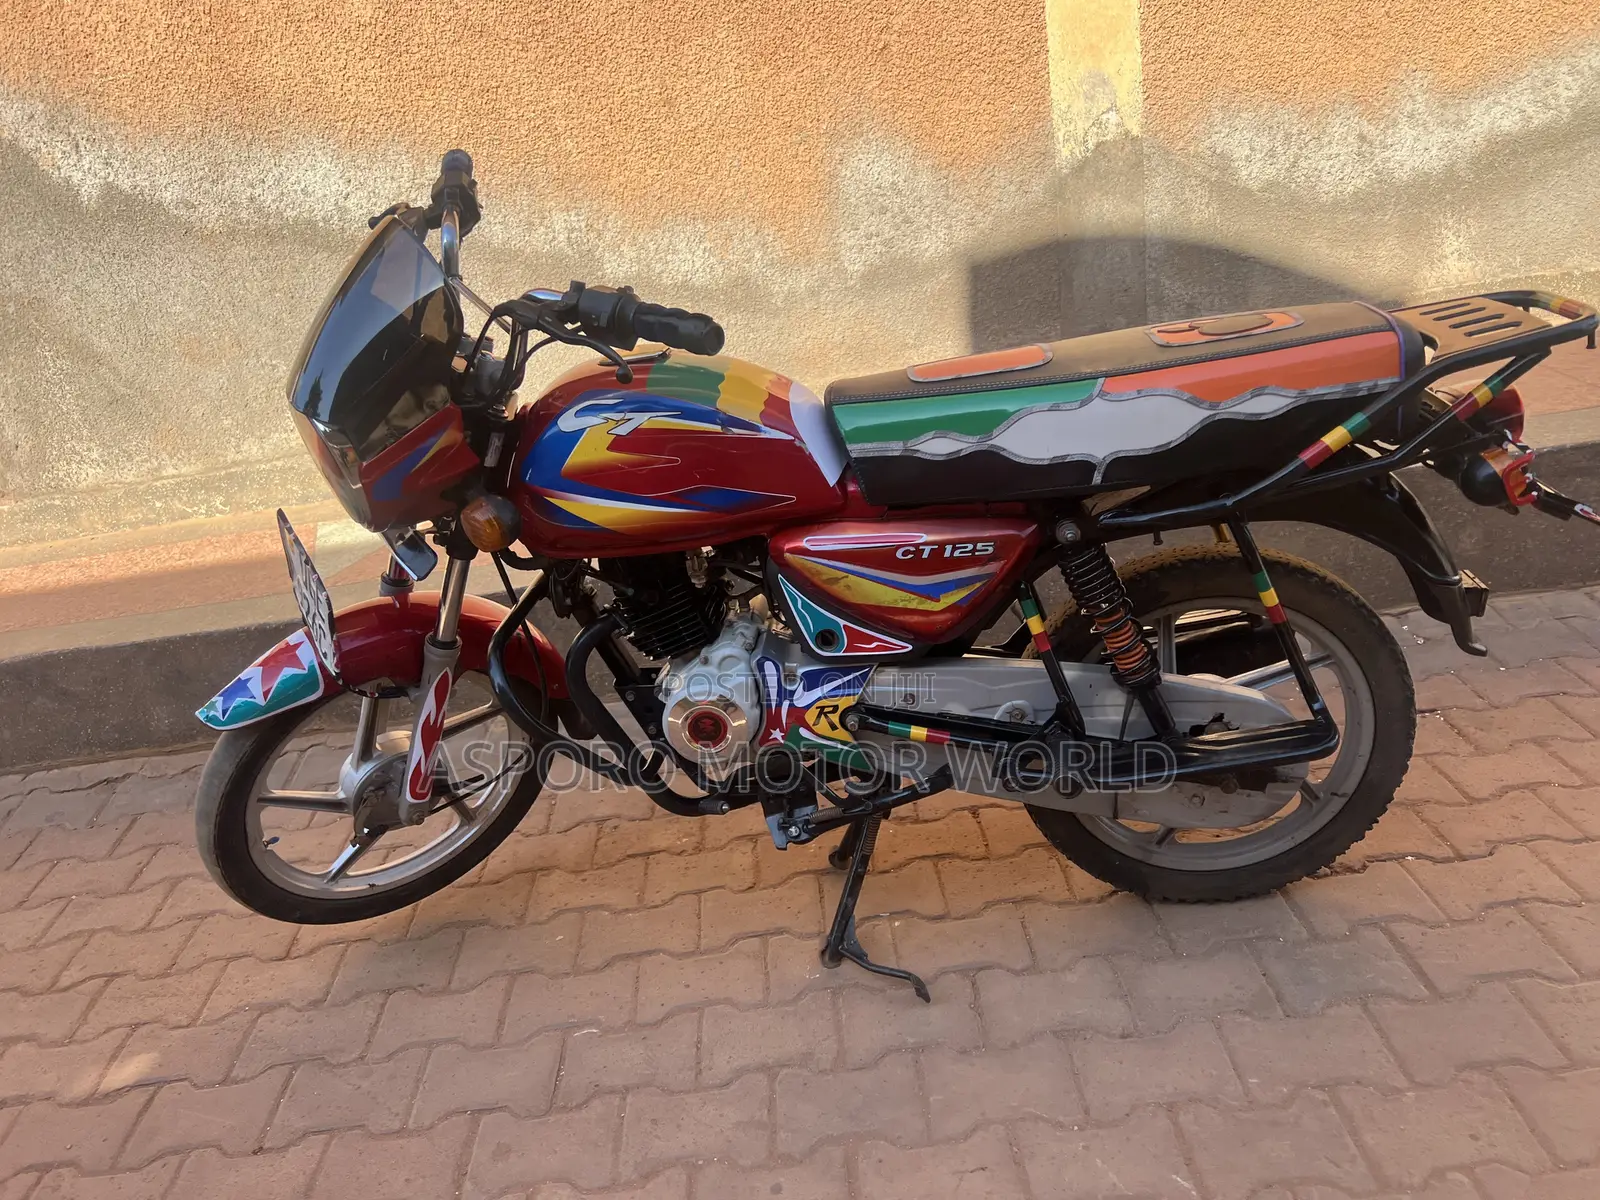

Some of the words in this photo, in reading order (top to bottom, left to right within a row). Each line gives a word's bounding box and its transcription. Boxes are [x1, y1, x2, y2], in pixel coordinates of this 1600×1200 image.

[896, 545, 938, 560] CT
[944, 542, 995, 558] 125
[812, 705, 839, 732] R
